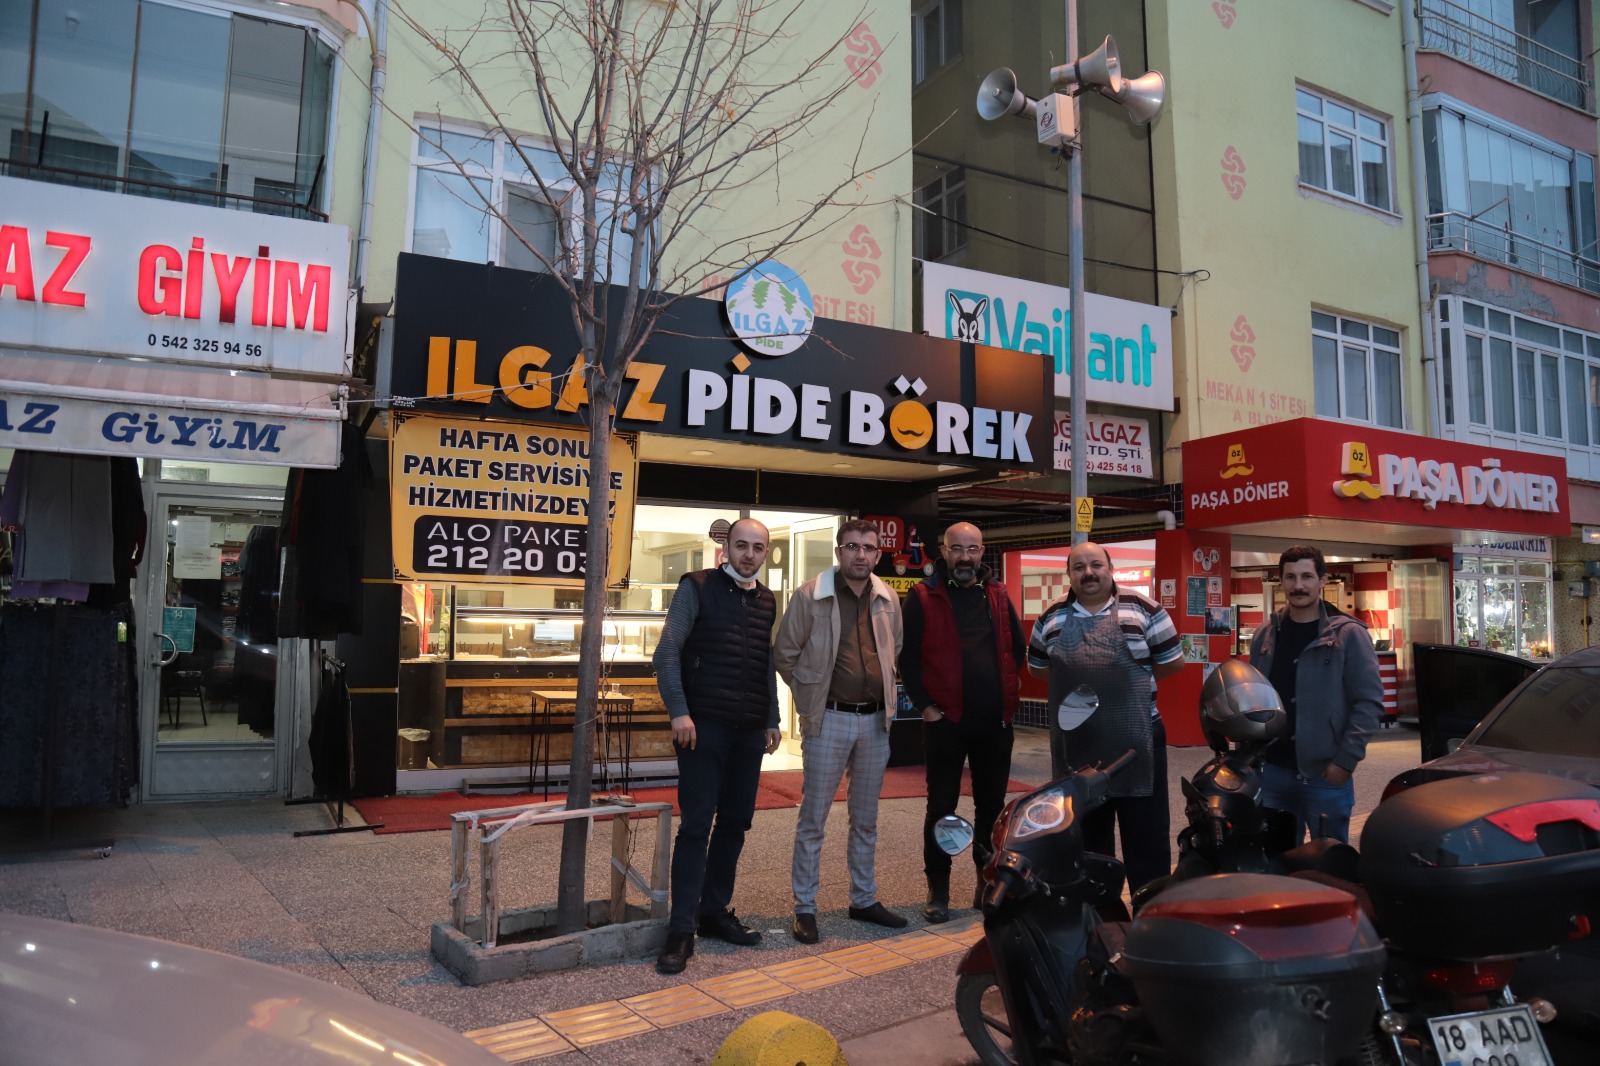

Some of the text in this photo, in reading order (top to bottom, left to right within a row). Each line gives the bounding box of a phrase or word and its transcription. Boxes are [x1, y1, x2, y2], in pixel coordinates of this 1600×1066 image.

[137, 236, 332, 332] GİYİM
[733, 312, 806, 335] ILGAZ
[148, 333, 262, 357] 0 542 325 94 56
[755, 337, 784, 350] PİDE
[993, 297, 1157, 387] Vailant
[426, 336, 1034, 463] ILGAZ PİDE BÖREK
[1233, 409, 1243, 423] A
[440, 427, 520, 452] HAFTA
[1117, 447, 1144, 460] ŞTİ.
[1352, 449, 1364, 462] ÖZ
[403, 454, 623, 490] PAKET SERVİSİYE
[1097, 461, 1114, 471] 425
[1116, 463, 1128, 472] 54
[1131, 464, 1142, 473] 18
[1191, 481, 1290, 510] PAŞA DÖNER
[1378, 453, 1560, 513] PAŞA DÖNER
[427, 521, 588, 547] ALO PAKE
[427, 544, 489, 569] 212
[502, 547, 545, 571] 20
[1437, 1015, 1533, 1052] 18 AAD
